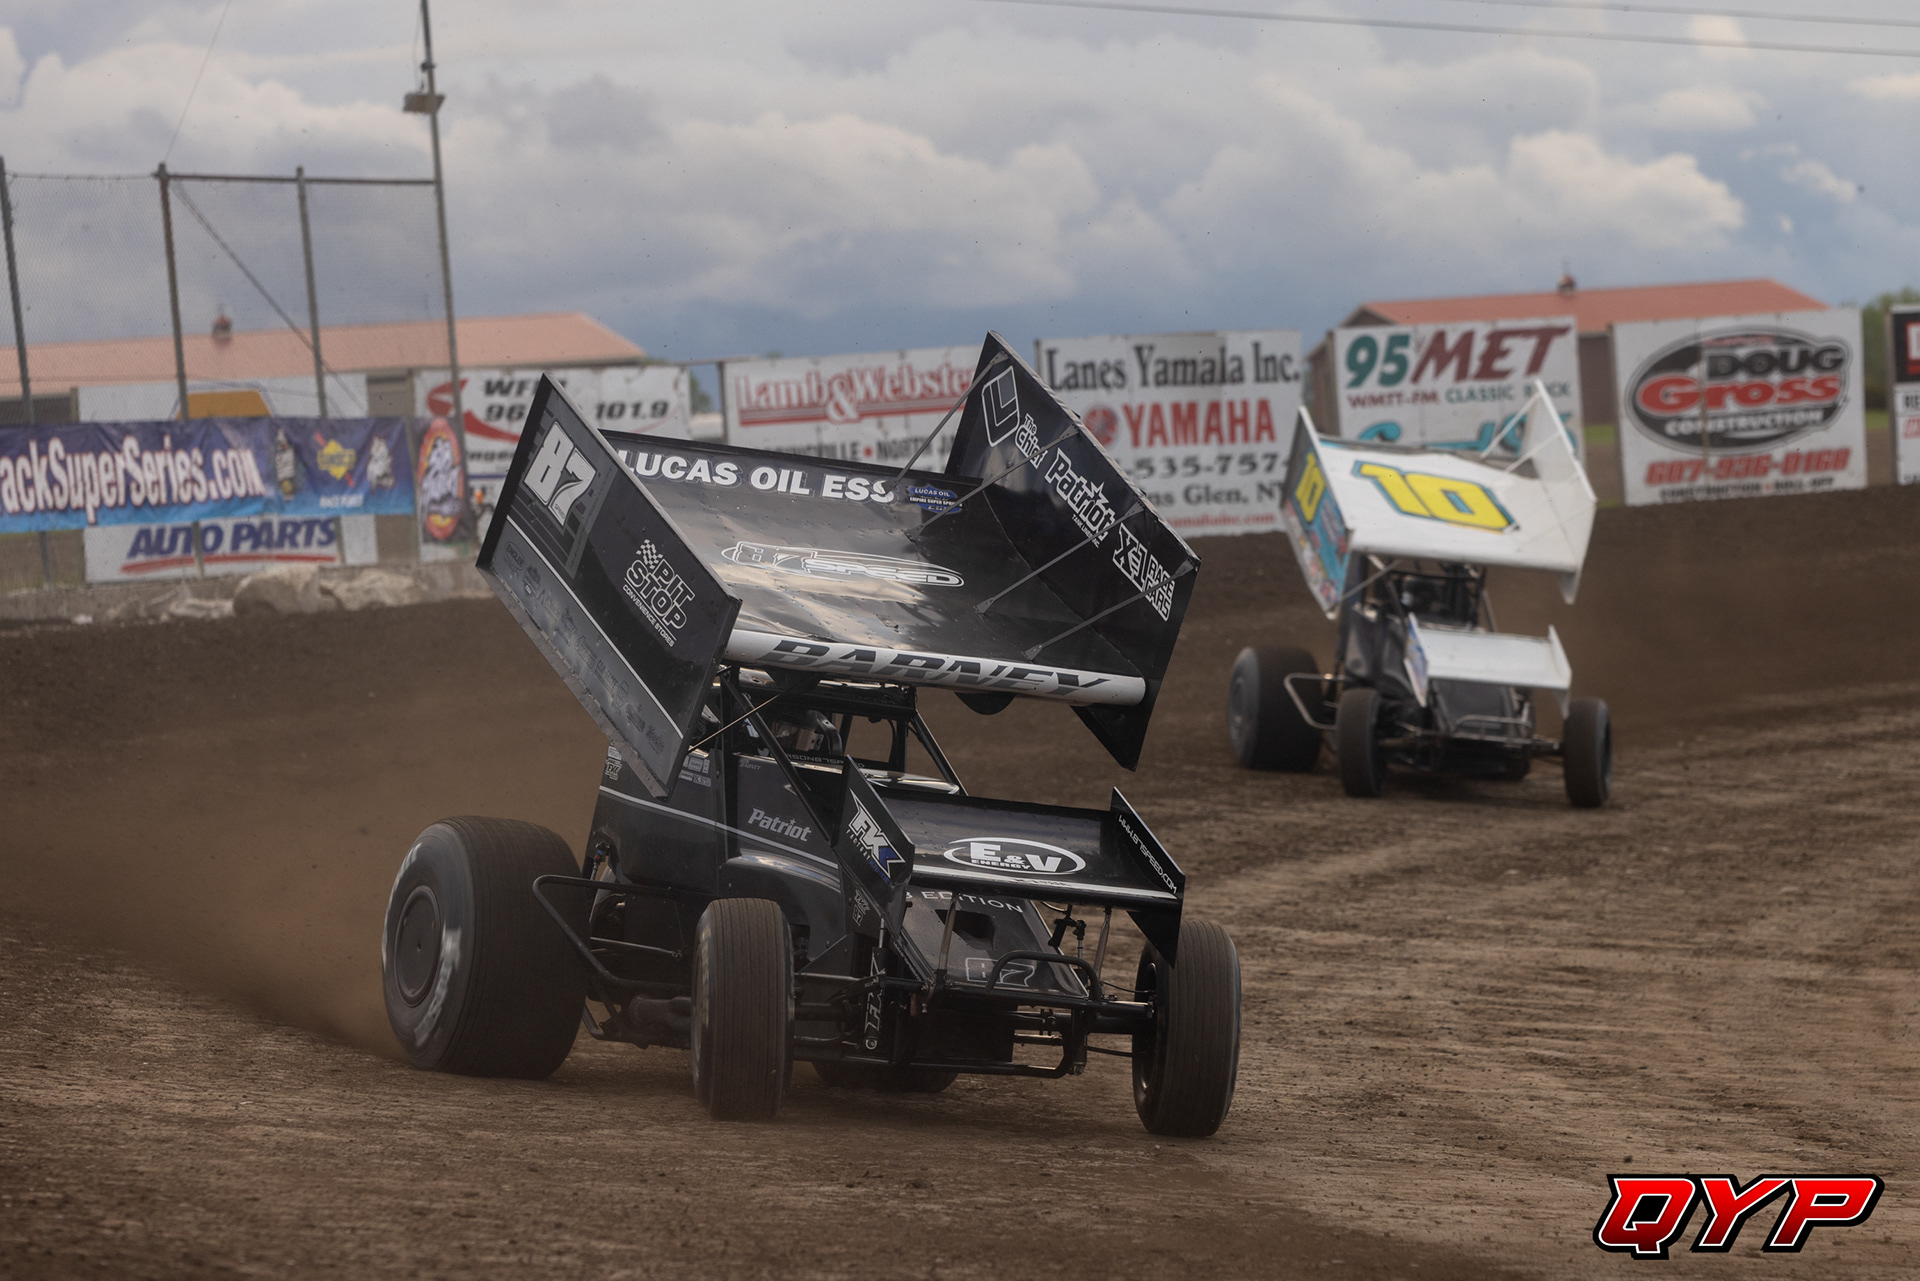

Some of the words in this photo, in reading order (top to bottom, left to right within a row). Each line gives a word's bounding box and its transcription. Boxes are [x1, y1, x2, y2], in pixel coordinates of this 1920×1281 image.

[1046, 347, 1127, 391] Lanes
[1251, 341, 1301, 382] Inc.
[1346, 333, 1411, 389] 95
[1411, 326, 1573, 384] MET
[1706, 346, 1845, 381] DOUG
[595, 401, 669, 420] 101.9
[1346, 391, 1440, 409] WMTT-FM
[1446, 384, 1514, 404] CLASSIC
[1524, 382, 1573, 399] RCK
[1639, 374, 1842, 415] Gross
[1121, 398, 1277, 449] YAMAHA
[1664, 409, 1824, 436] CONSTRUCTION
[0, 434, 267, 526] ackSuperSeries.com
[523, 422, 597, 527] 87
[616, 450, 739, 487] LUCAS
[750, 467, 810, 495] OIL
[821, 475, 895, 504] ESS
[1044, 447, 1117, 542] Patriot
[1183, 484, 1249, 507] Glen,
[1354, 461, 1516, 534] 10
[127, 524, 224, 559] AUTO
[231, 518, 336, 552] PARTS
[626, 560, 687, 630] STOP
[654, 559, 696, 608] PIT
[802, 556, 963, 587] SPEED
[622, 584, 658, 628] CONVENIENCE
[653, 623, 675, 648] STORES
[756, 638, 1111, 697] BARNEY
[747, 807, 812, 842] Patriot
[969, 841, 1063, 873] E&V
[971, 858, 1031, 871] ENERGY
